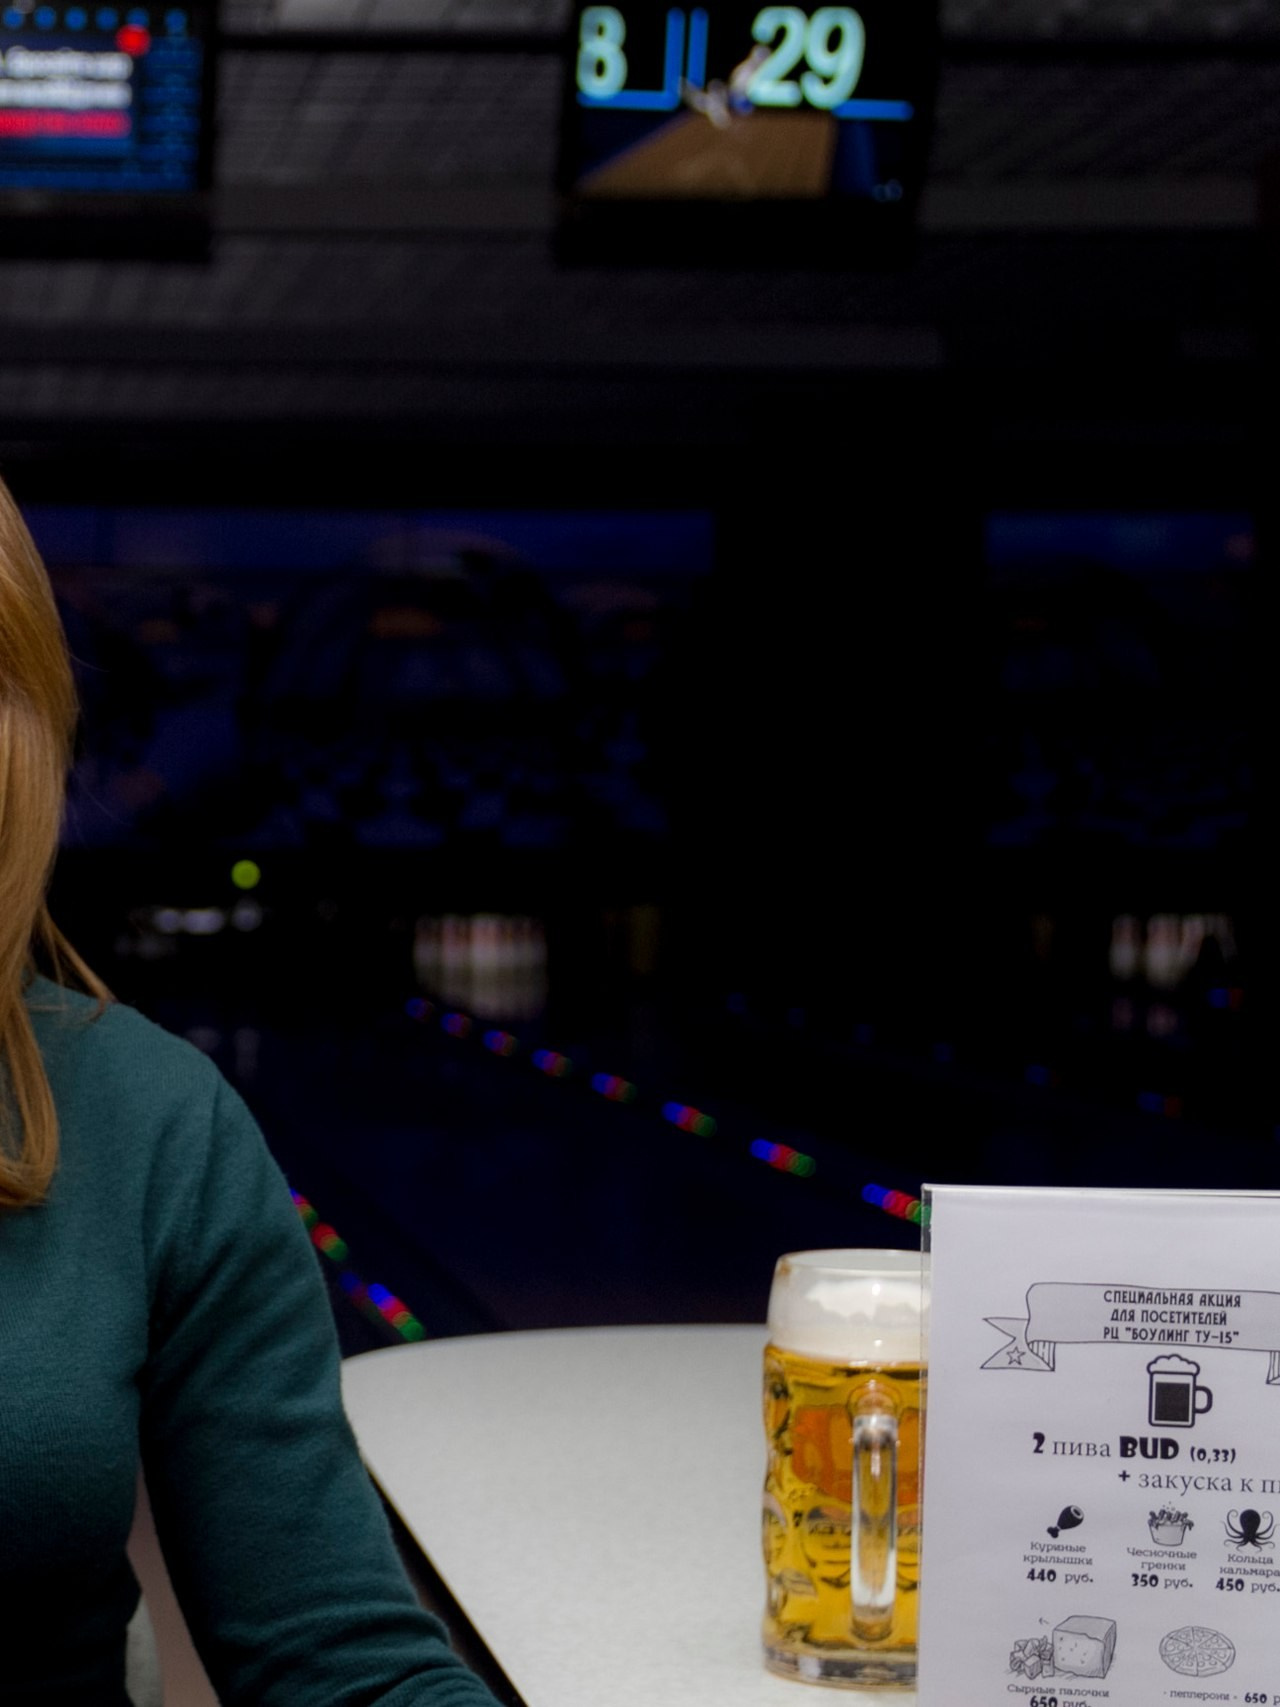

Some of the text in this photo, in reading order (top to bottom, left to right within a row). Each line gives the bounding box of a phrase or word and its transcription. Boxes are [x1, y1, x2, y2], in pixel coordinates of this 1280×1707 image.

[747, 5, 866, 109] 29
[1103, 1289, 1241, 1308] СПЕЦИАЛЬНАЯ АКЦИЯ
[1110, 1309, 1228, 1326] ДЛЯ ПОСЕТИТЕЛЕЙ
[1103, 1326, 1240, 1344] РЦ "БОУЛИНГ ТУ-15"
[1032, 1432, 1236, 1464] 2 пива BUD (0,33)
[1138, 1473, 1232, 1496] закуска
[1240, 1477, 1253, 1493] к
[1030, 1541, 1087, 1553] Куриные
[1126, 1547, 1198, 1559] Чесночные
[1023, 1554, 1093, 1566] крылышки
[1141, 1561, 1186, 1571] гренки
[1227, 1553, 1274, 1565] Кольца
[1026, 1567, 1094, 1584] 440 руб.
[1219, 1566, 1280, 1578] кальмара
[1131, 1573, 1194, 1589] 350 руб.
[1215, 1577, 1245, 1592] 450
[1007, 1683, 1110, 1698] Сырные палочки
[1170, 1690, 1230, 1701] пепперони
[1244, 1692, 1268, 1704] 650
